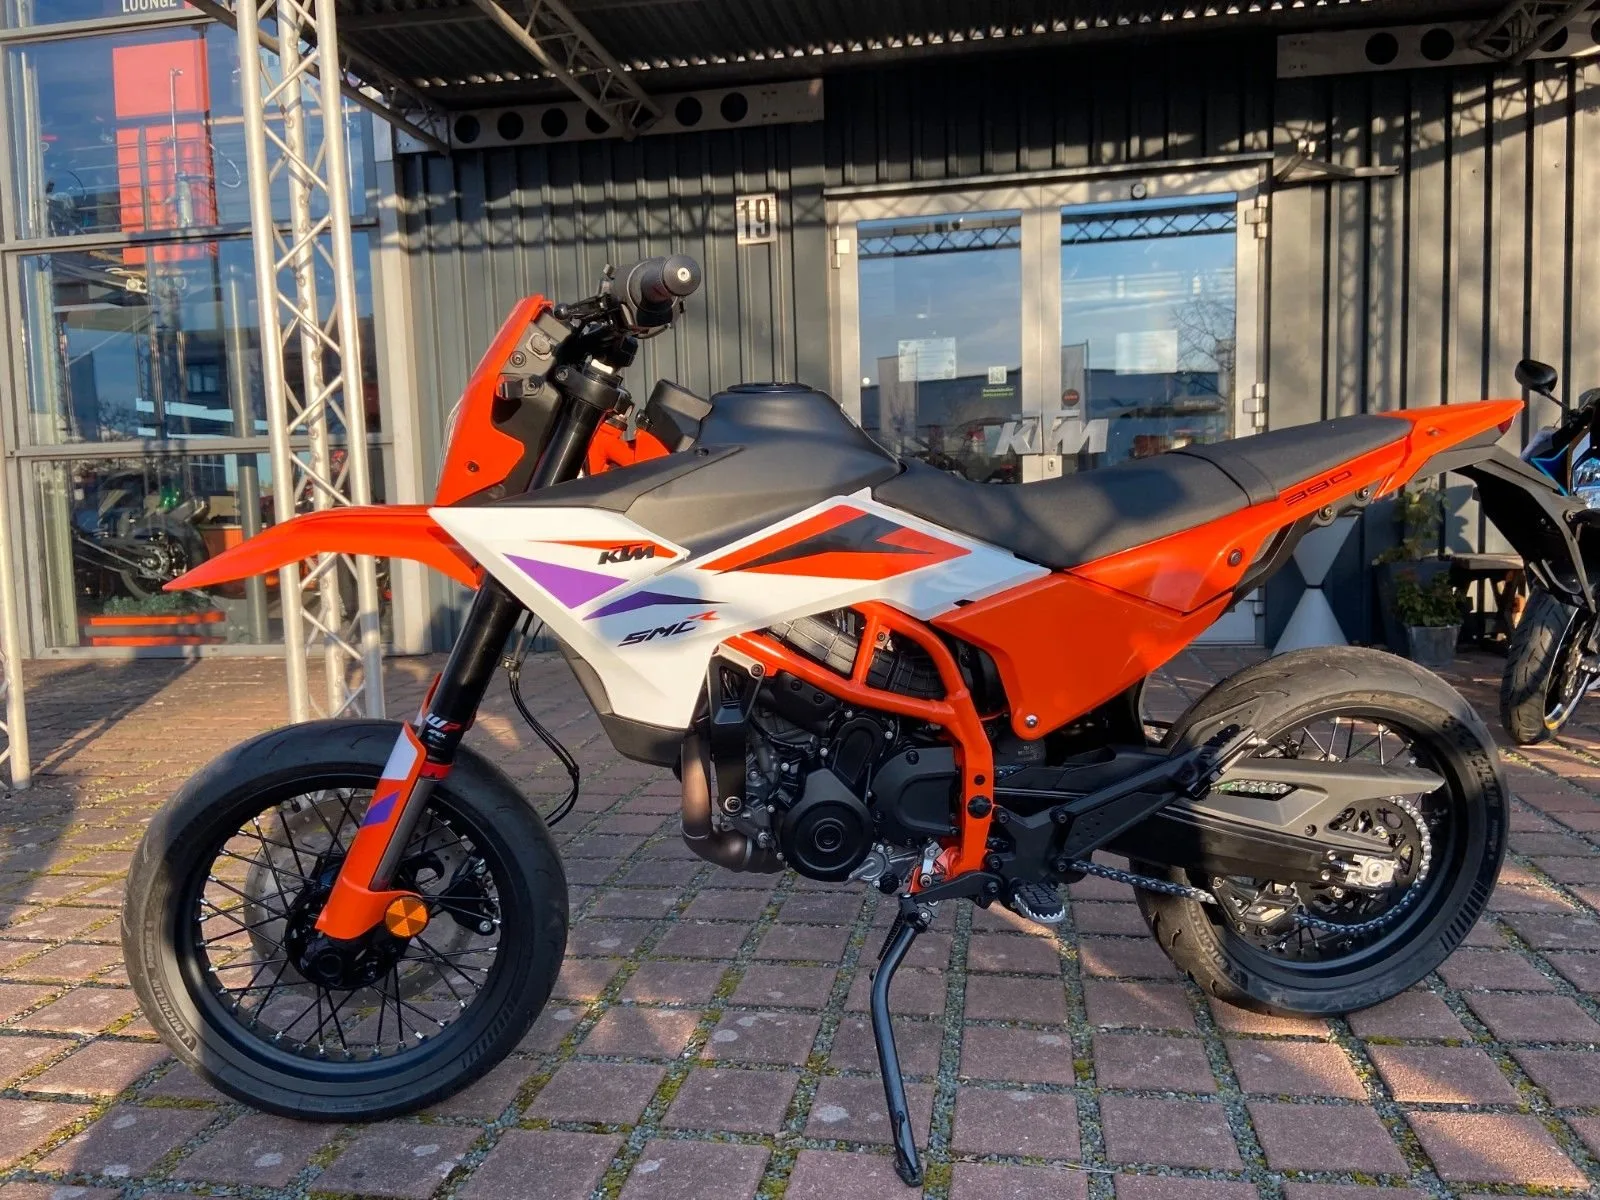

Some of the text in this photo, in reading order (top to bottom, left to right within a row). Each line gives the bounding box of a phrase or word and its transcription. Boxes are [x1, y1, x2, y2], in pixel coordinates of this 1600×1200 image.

[740, 199, 770, 238] 19
[993, 409, 1109, 455] KTM
[1284, 470, 1353, 507] 390
[598, 543, 655, 565] KTM
[617, 620, 697, 648] SMC
[152, 979, 185, 1033] MICHELIN
